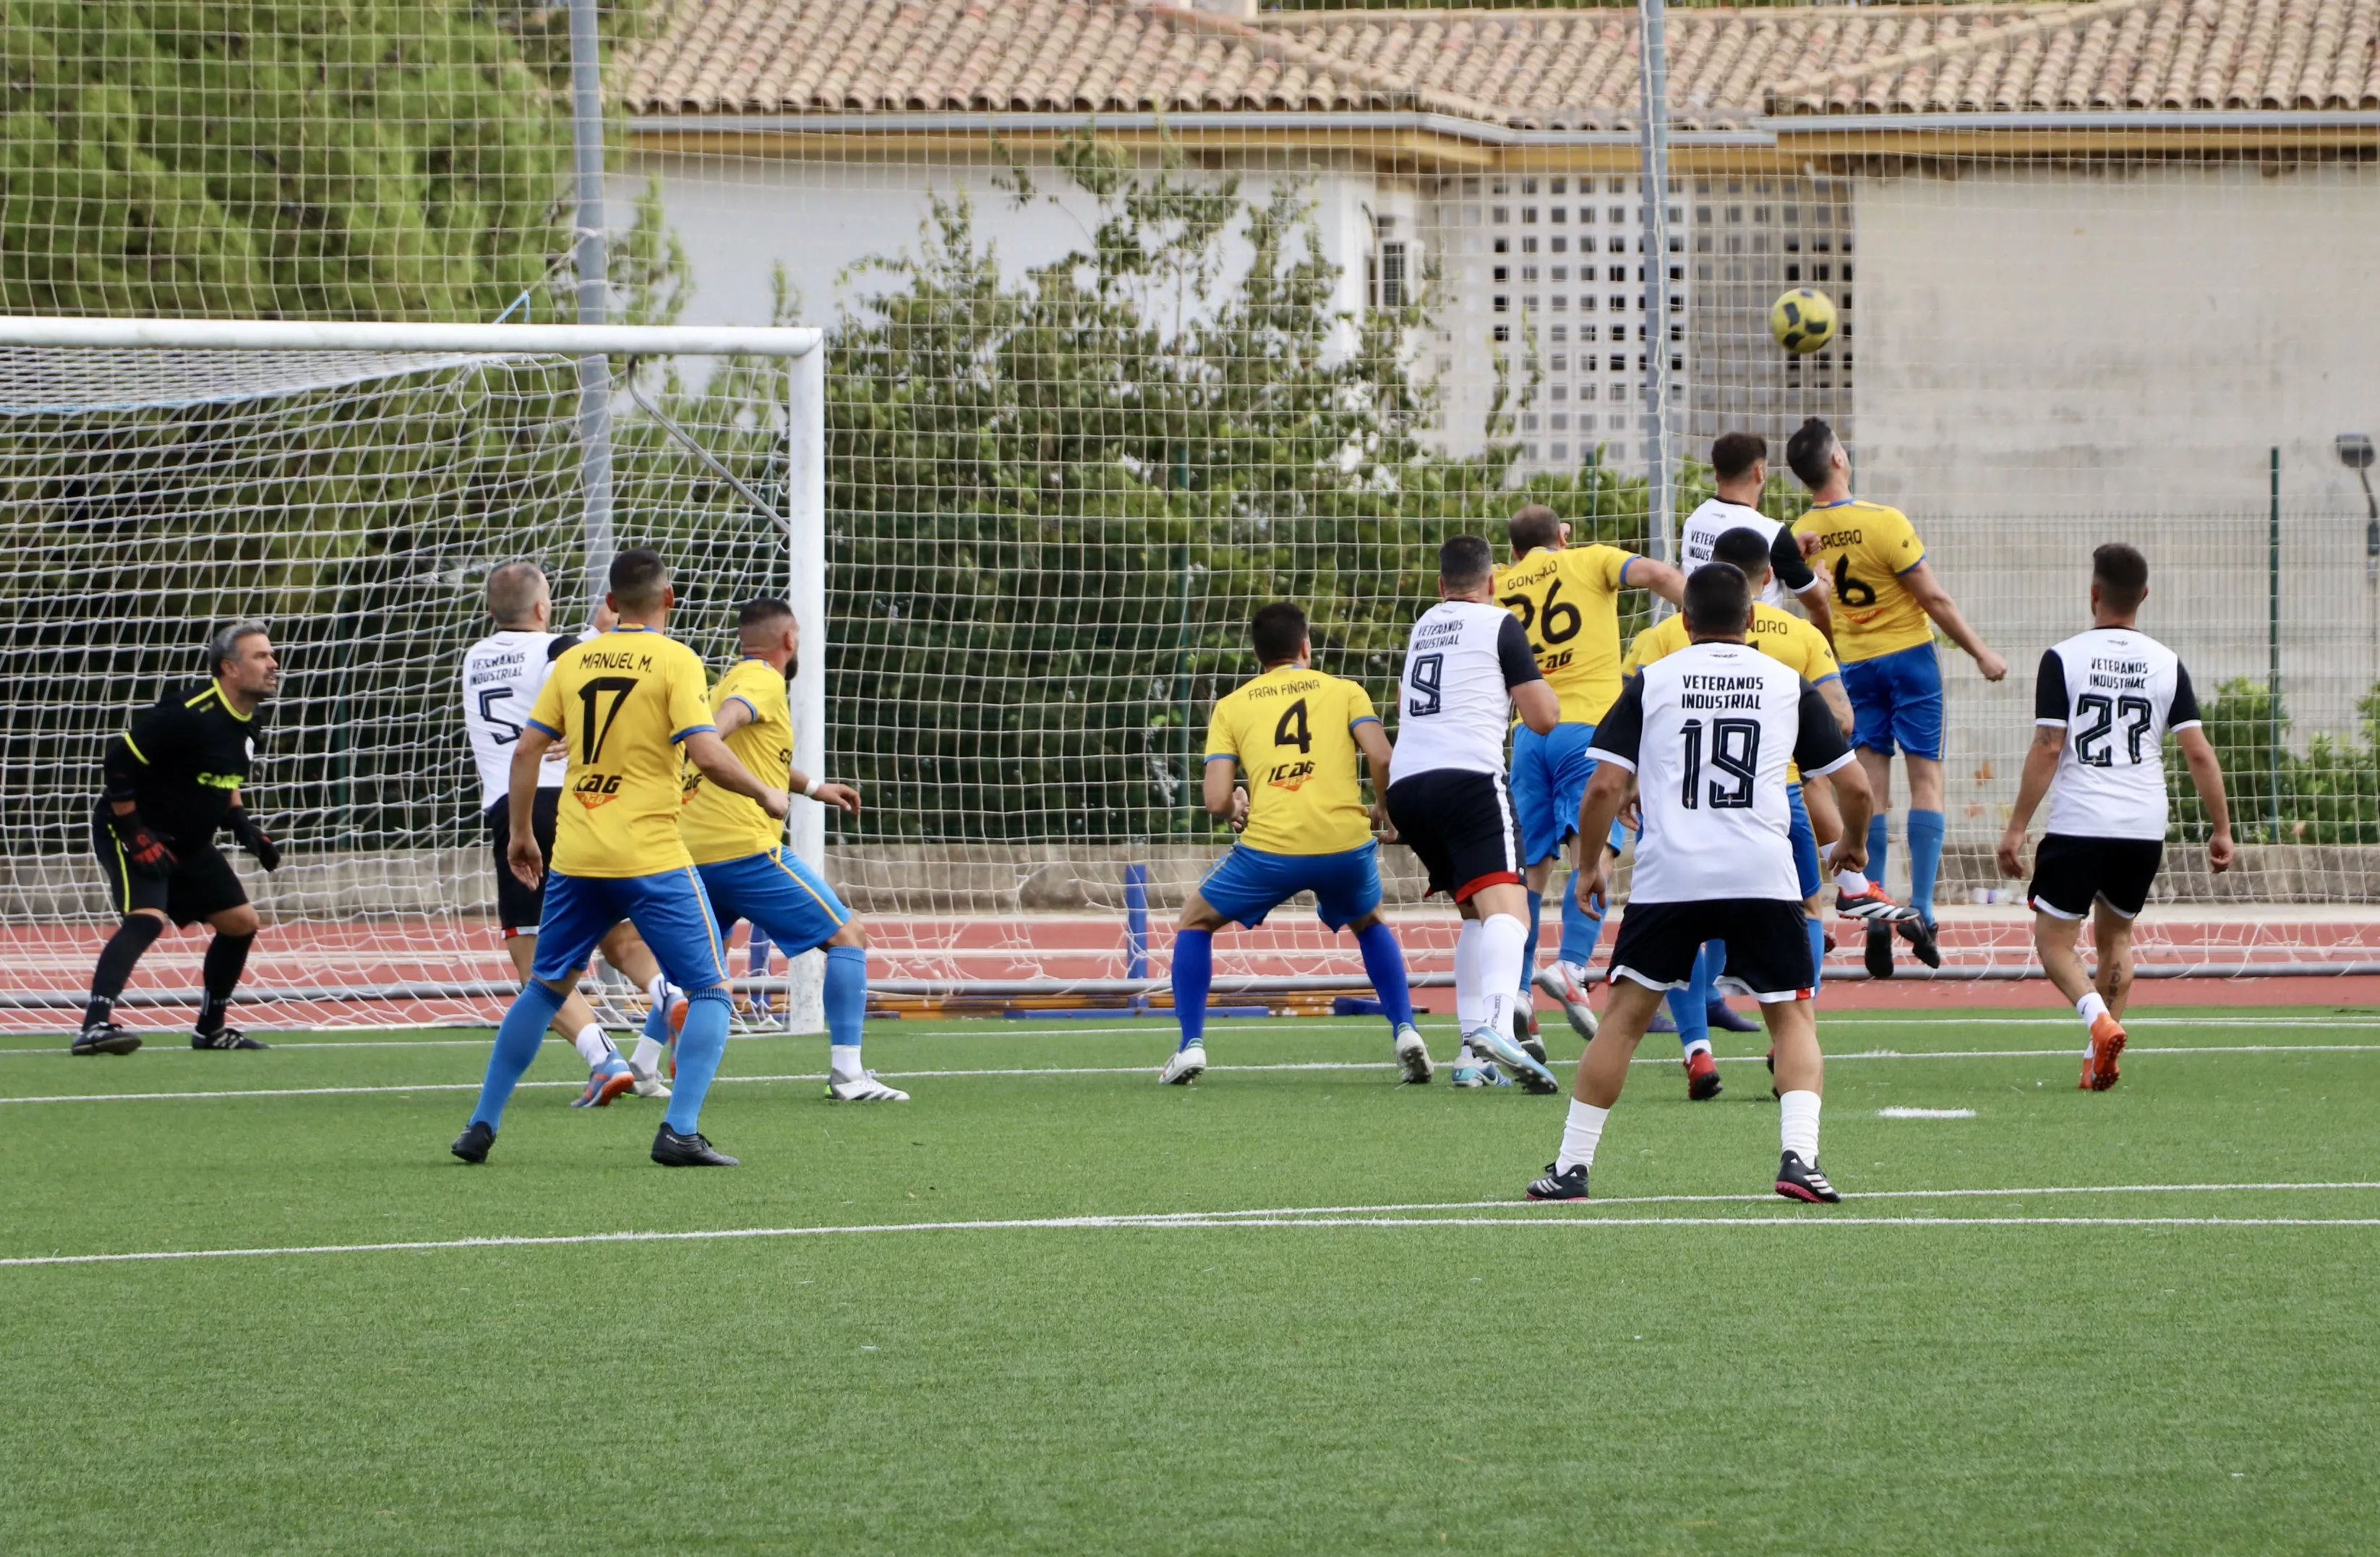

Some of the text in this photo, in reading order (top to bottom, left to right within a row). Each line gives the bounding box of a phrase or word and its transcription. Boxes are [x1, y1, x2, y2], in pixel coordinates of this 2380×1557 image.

[1820, 529, 1862, 550] ACERO
[1835, 553, 1877, 607] 6
[1499, 576, 1582, 654] 26
[1418, 619, 1465, 637] VETERANOS
[1412, 634, 1460, 652] INDUSTRIAL
[579, 652, 652, 673] MANUEL M.
[2091, 657, 2149, 674] VETERANOS
[1249, 678, 1321, 700] FRAN FIÑANA
[1410, 652, 1444, 717] 9
[1682, 675, 1763, 691] VETERANOS
[2089, 673, 2146, 689] INDUSTRIAL
[1682, 693, 1761, 709] INDUSTRIAL
[479, 686, 523, 745] 5
[578, 676, 639, 765] 17
[1275, 697, 1312, 754] 4
[2075, 694, 2152, 767] 27
[1679, 717, 1761, 809] 19
